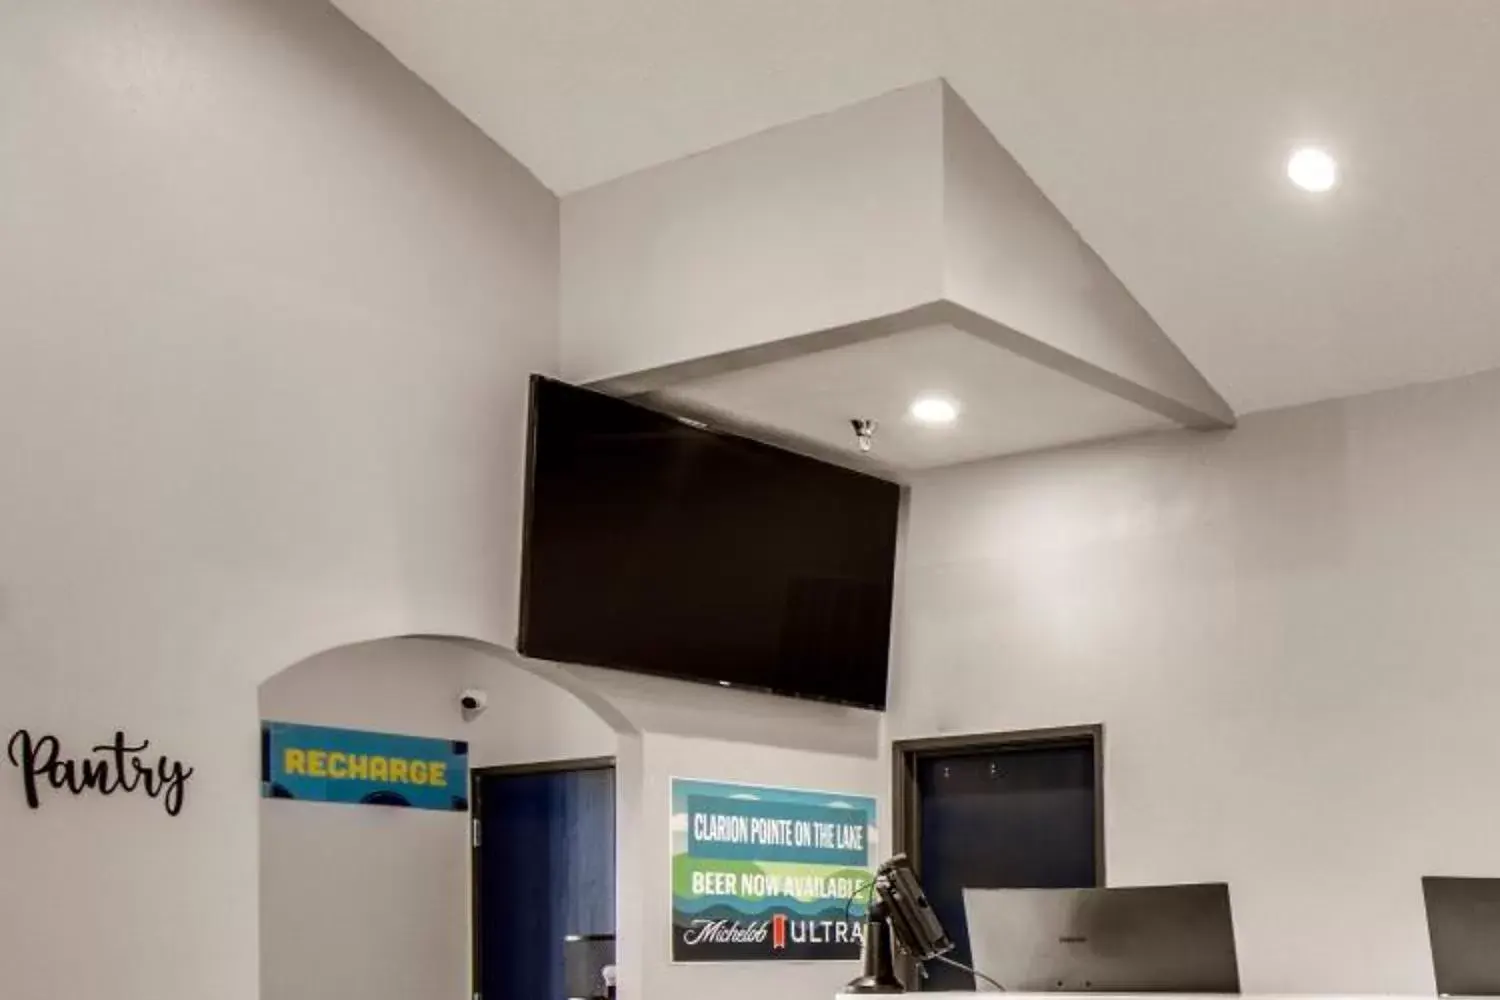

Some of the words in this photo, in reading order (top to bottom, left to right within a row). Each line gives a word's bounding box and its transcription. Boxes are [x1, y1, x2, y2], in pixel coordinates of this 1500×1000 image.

[8, 729, 193, 817] Pantry
[285, 749, 447, 787] RECHARGE
[694, 812, 749, 844] CLARION
[751, 817, 792, 846] POINTE
[795, 820, 811, 847] ON
[813, 822, 835, 849] THE
[837, 824, 864, 851] LAKE
[692, 870, 737, 895] BEER
[741, 873, 784, 898] NOW
[783, 875, 864, 899] AVAILABLE
[683, 918, 768, 945] Michelob
[791, 918, 864, 944] ULTRA
